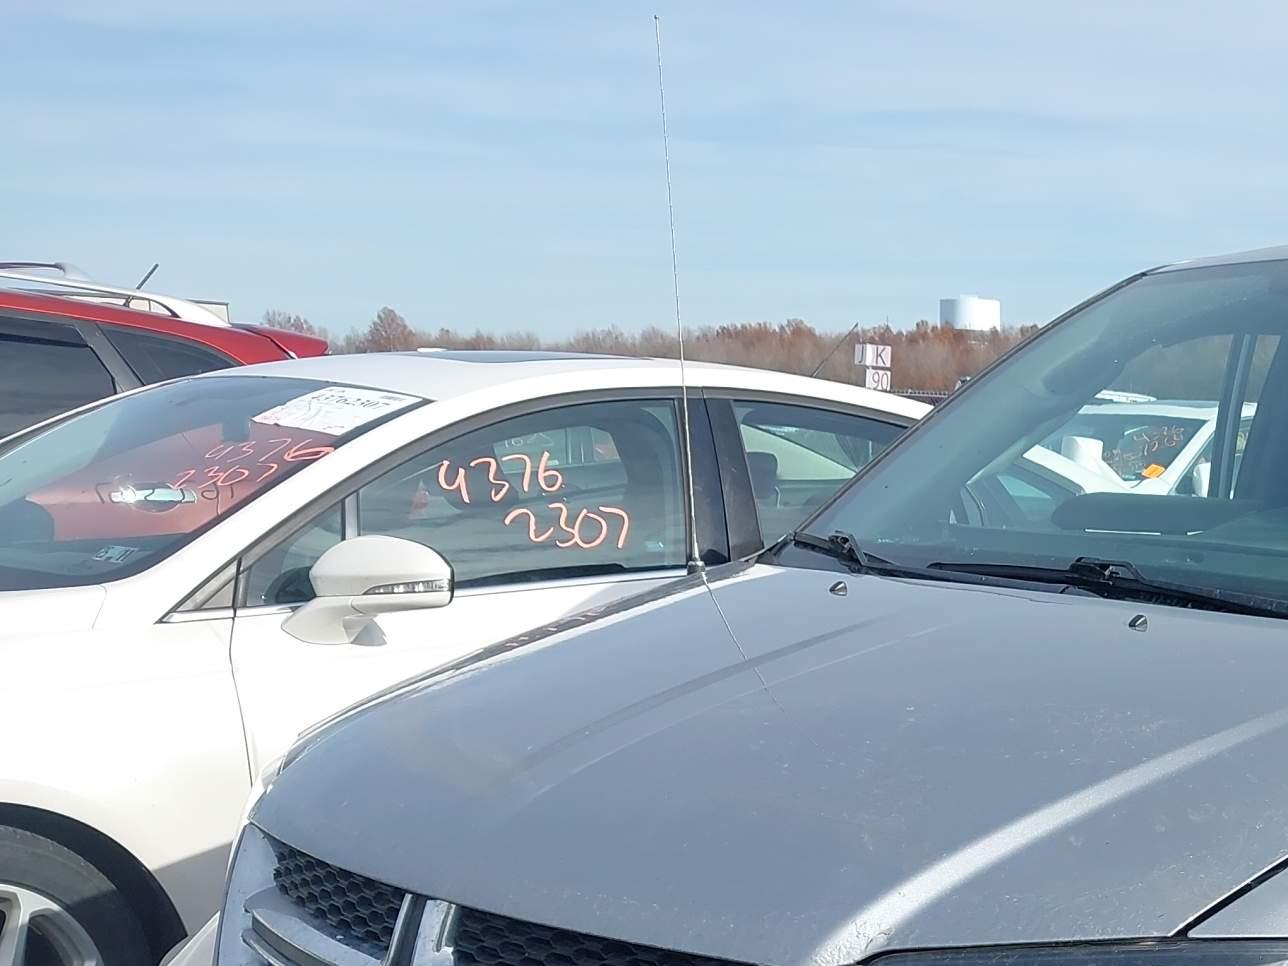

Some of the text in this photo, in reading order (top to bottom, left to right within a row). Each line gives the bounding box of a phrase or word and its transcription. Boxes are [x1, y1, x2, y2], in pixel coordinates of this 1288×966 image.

[875, 346, 887, 366] K
[872, 371, 889, 391] 90
[205, 437, 336, 463] 4376
[165, 462, 279, 490] 2307
[436, 449, 565, 504] 4376
[504, 501, 630, 550] 2307
